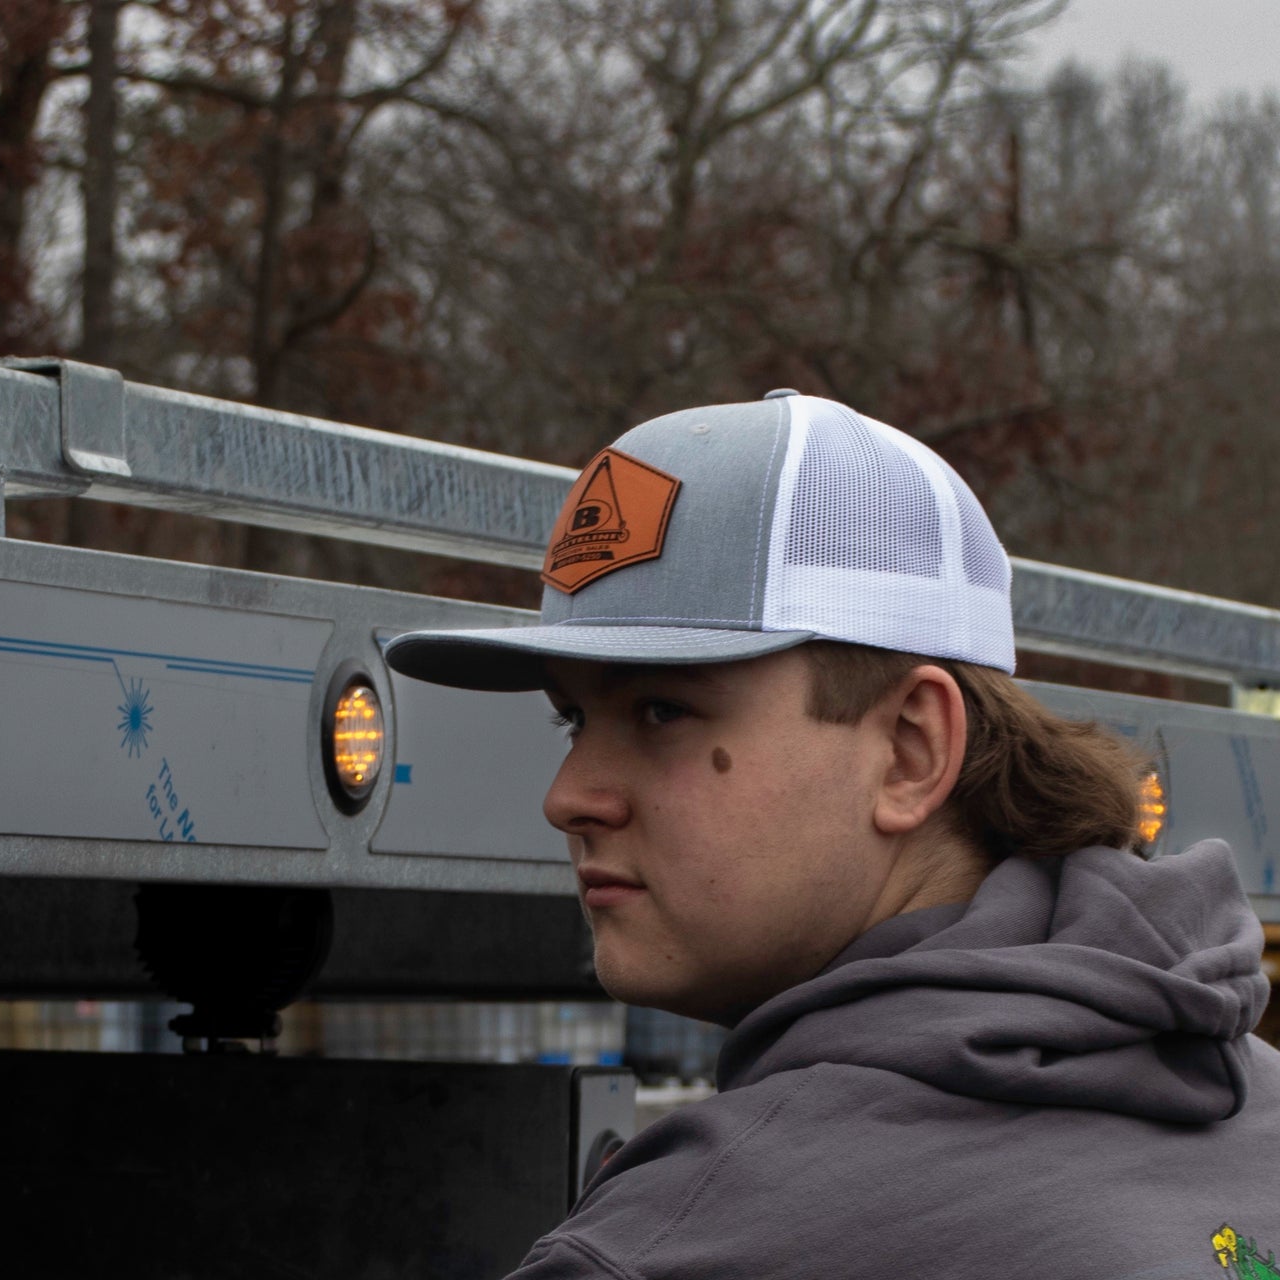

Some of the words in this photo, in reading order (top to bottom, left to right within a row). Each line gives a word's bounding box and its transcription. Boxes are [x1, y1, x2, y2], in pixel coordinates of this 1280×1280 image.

[571, 505, 602, 531] B
[146, 784, 162, 819] for
[159, 757, 178, 811] The
